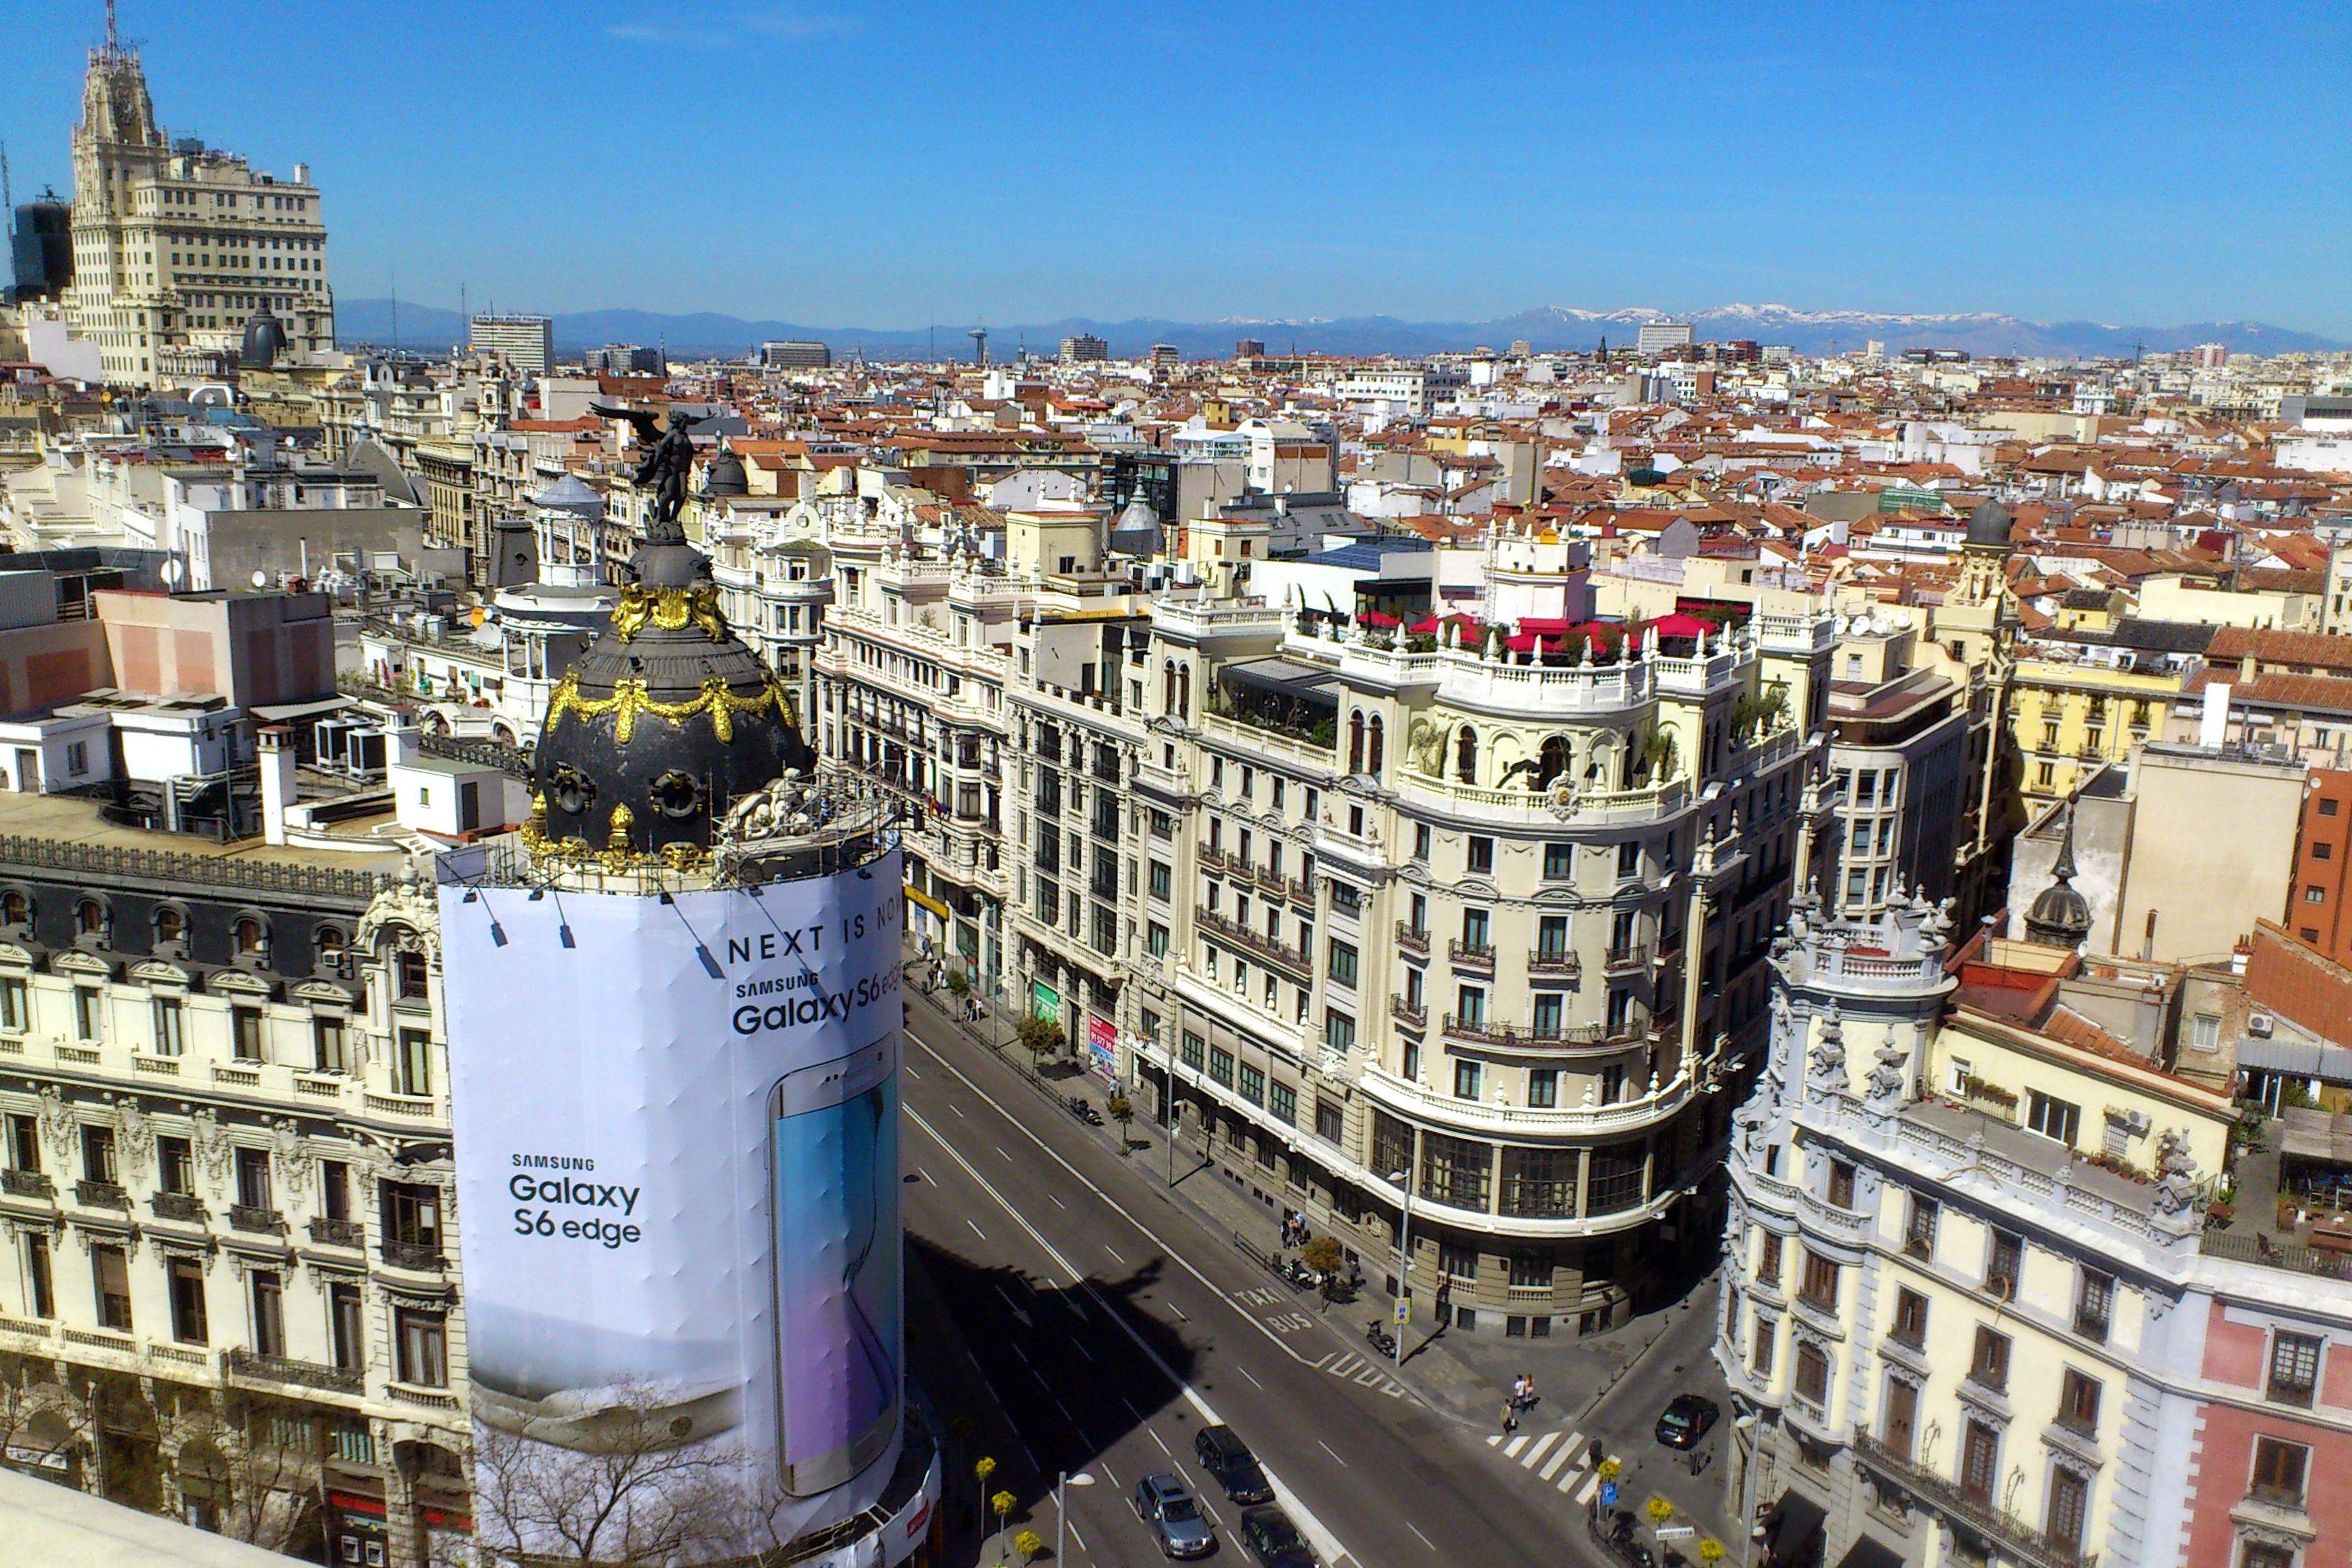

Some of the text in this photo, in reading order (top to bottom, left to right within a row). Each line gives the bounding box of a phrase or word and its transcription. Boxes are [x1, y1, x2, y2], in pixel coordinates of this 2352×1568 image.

[729, 925, 824, 964] NEXT
[844, 914, 865, 943] IS
[736, 973, 819, 998] SAMSUNG
[733, 989, 854, 1035] Galaxy
[857, 974, 880, 1007] S6
[512, 1154, 595, 1171] SAMSUNG
[509, 1174, 641, 1216] Galaxy
[514, 1208, 641, 1250] S6 edge
[1233, 1286, 1287, 1307] TAXI
[1265, 1312, 1313, 1333] BUS
